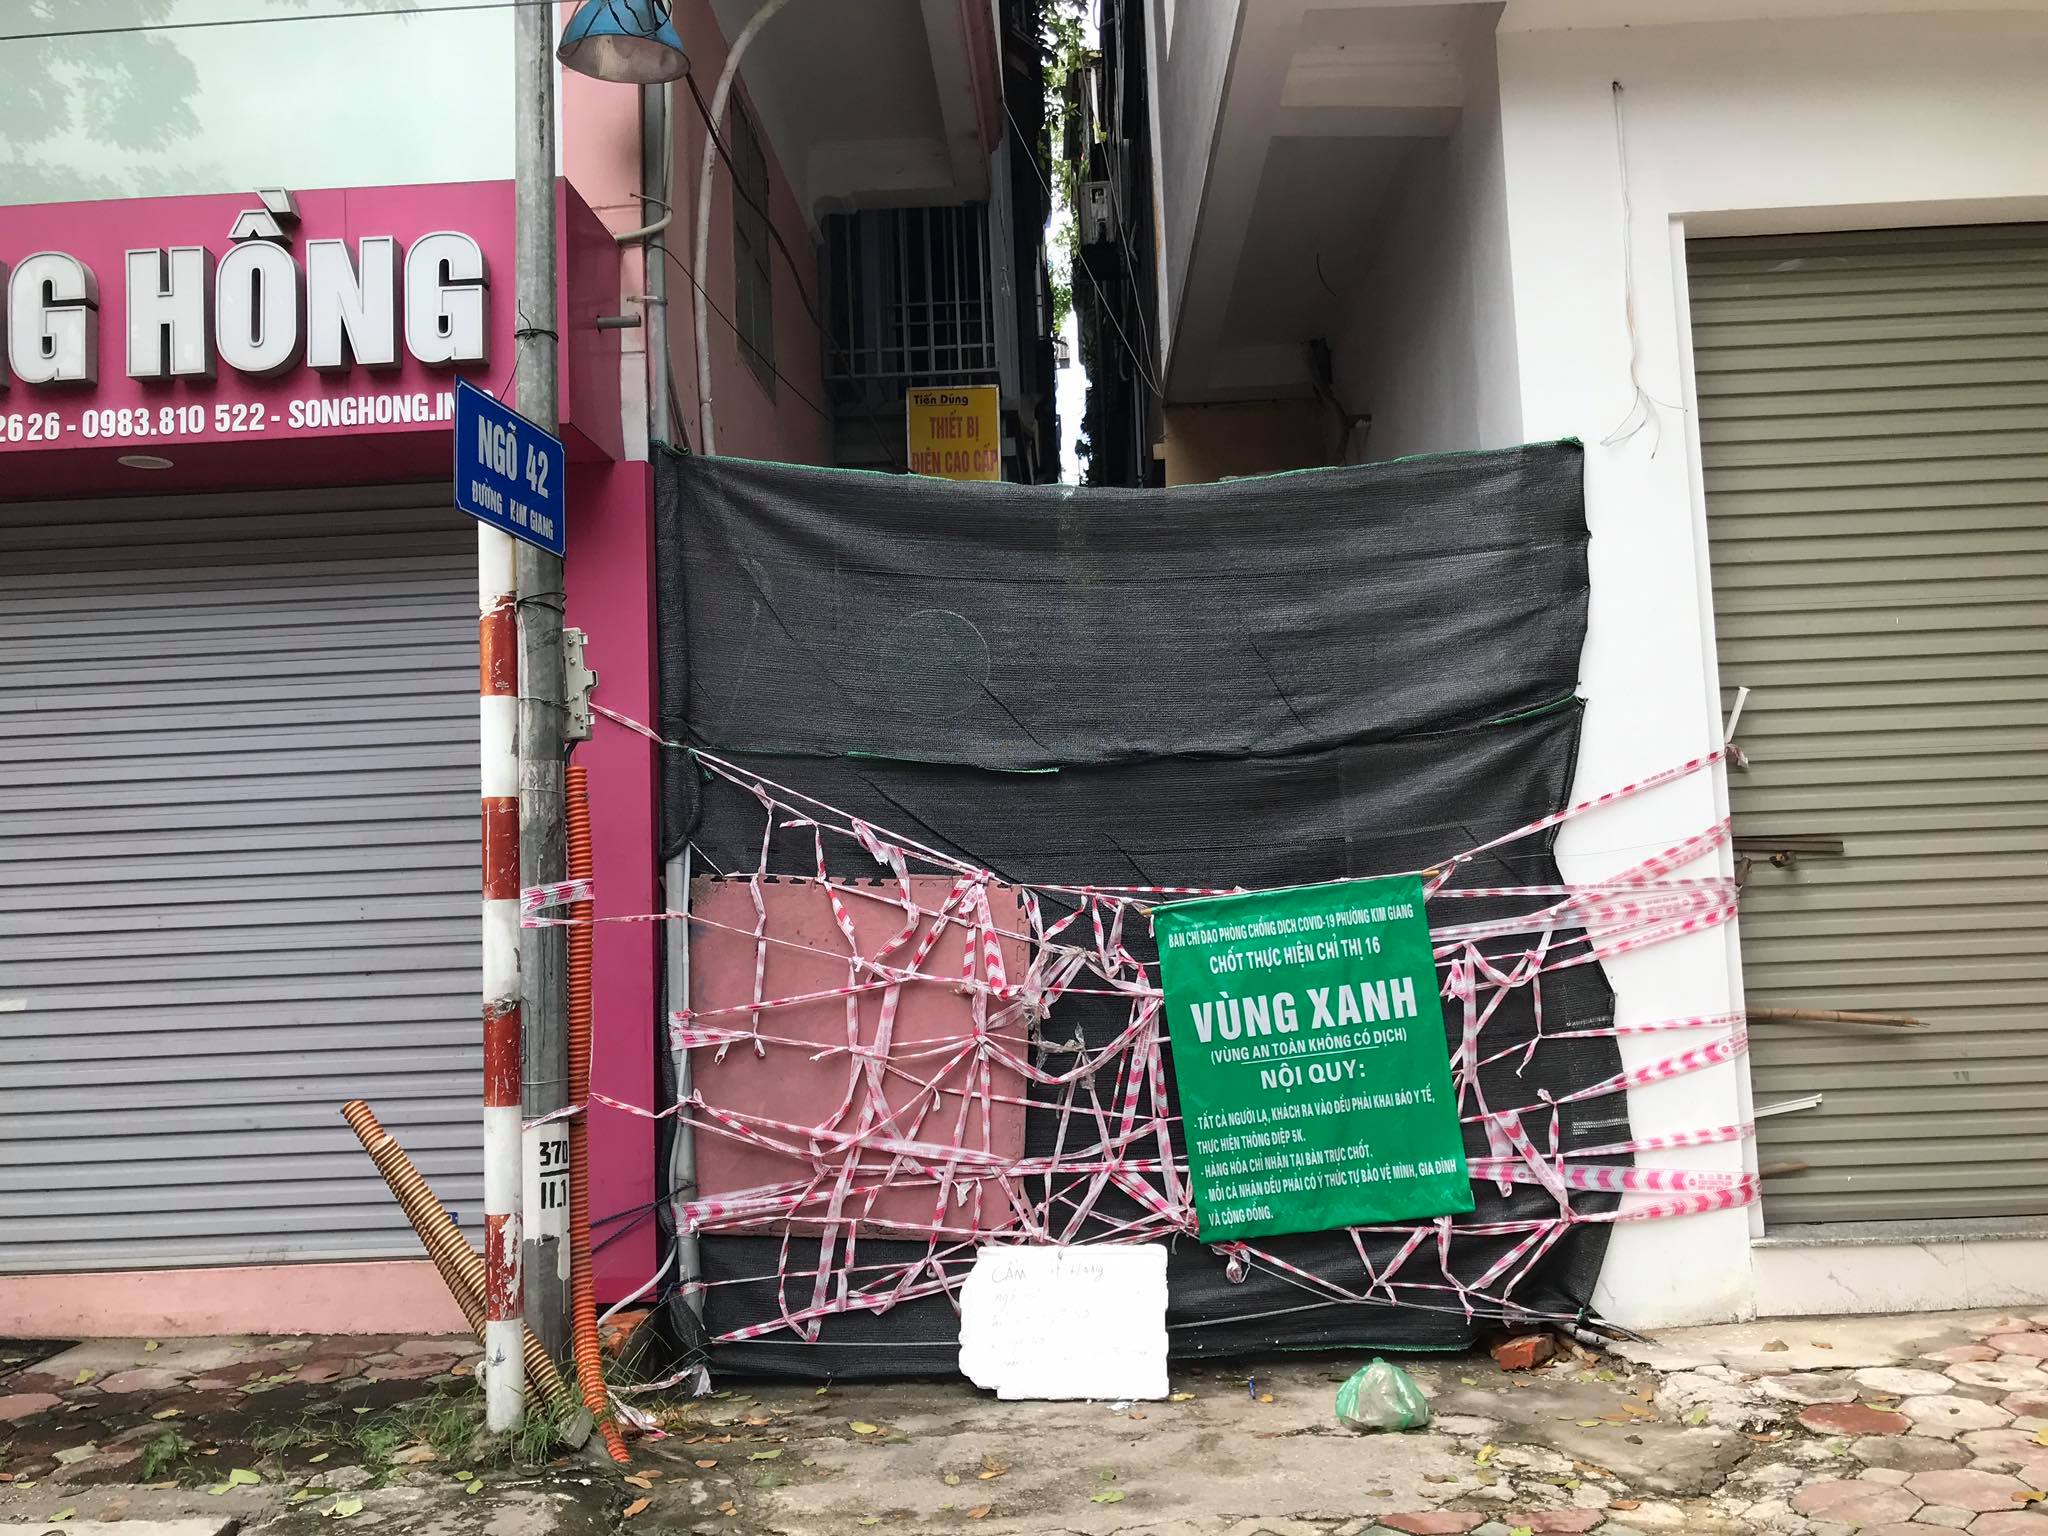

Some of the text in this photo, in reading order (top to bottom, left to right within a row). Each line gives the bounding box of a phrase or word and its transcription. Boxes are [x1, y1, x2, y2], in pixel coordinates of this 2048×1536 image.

[125, 187, 490, 378] HỒNG
[913, 393, 969, 406] Tiến Dũng
[82, 406, 205, 438] 0983.810
[214, 403, 265, 432] 522
[929, 410, 980, 442] THIẾT BỊ
[478, 414, 549, 499] NGÕ 42
[944, 450, 970, 473] CAO
[973, 442, 998, 474] CẤP
[471, 478, 554, 541] ĐƯỜNG KIM GIANG
[1168, 932, 1186, 948] BAN
[1218, 922, 1248, 942] PHÒNG
[1247, 915, 1277, 938] CHỐNG
[1276, 918, 1298, 938] DỊCH
[1297, 913, 1335, 933] COVID-19
[1335, 905, 1371, 927] PHƯỜNG
[1370, 906, 1387, 923] KIM
[1387, 903, 1414, 921] GIANG
[1209, 932, 1381, 975] CHỐT THỰC HIỆN CHỈ THỊ 16
[1190, 991, 1299, 1043] VÙNG
[1306, 976, 1418, 1030] XANH
[1210, 1027, 1408, 1065] (VÙNG AN TOÀN KHÔNG CÓ DỊCH)
[1260, 1058, 1366, 1094] NỘI QUY:
[1198, 1109, 1215, 1131] TẤT
[1215, 1108, 1229, 1128] CẢ
[1228, 1107, 1257, 1126] NGƯỜI
[1256, 1108, 1272, 1126] LẠ,
[1271, 1102, 1301, 1121] KHÁCH
[1301, 1104, 1315, 1118] RA
[1314, 1098, 1334, 1116] VÀO
[1351, 1090, 1373, 1111] PHẢI
[1372, 1093, 1395, 1109] KHAI
[1394, 1088, 1414, 1106] BÁO
[1413, 1090, 1421, 1104] Y
[1420, 1082, 1436, 1104] TẾ,
[538, 1140, 569, 1167] 370
[1196, 1138, 1221, 1158] THỰC
[1220, 1134, 1241, 1155] HIỆN
[1240, 1130, 1271, 1149] THÔNG
[1291, 1128, 1307, 1143] 5K.
[1204, 1160, 1230, 1179] HÀNG
[1229, 1156, 1250, 1176] HÓA
[1248, 1152, 1265, 1173] CHỈ
[1264, 1151, 1290, 1173] NHẬN
[1289, 1152, 1305, 1171] TẠI
[1304, 1148, 1325, 1167] BÀN
[1324, 1147, 1348, 1167] TRỰC
[1346, 1138, 1374, 1161] CHỐT.
[1207, 1181, 1226, 1203] MỖI
[1225, 1181, 1240, 1201] CÁ
[1238, 1180, 1264, 1198] NHÂN
[1282, 1171, 1304, 1193] PHẢI
[1303, 1172, 1318, 1191] CÓ
[1316, 1172, 1325, 1189] Ý
[1323, 1169, 1348, 1189] THỨC
[1347, 1166, 1361, 1189] TỰ
[1360, 1163, 1380, 1183] BẢO
[1379, 1162, 1393, 1184] VỆ
[1392, 1161, 1419, 1180] MÌNH,
[1418, 1161, 1436, 1177] GIA
[1207, 1209, 1222, 1227] VÀ
[1220, 1207, 1247, 1229] CỘNG
